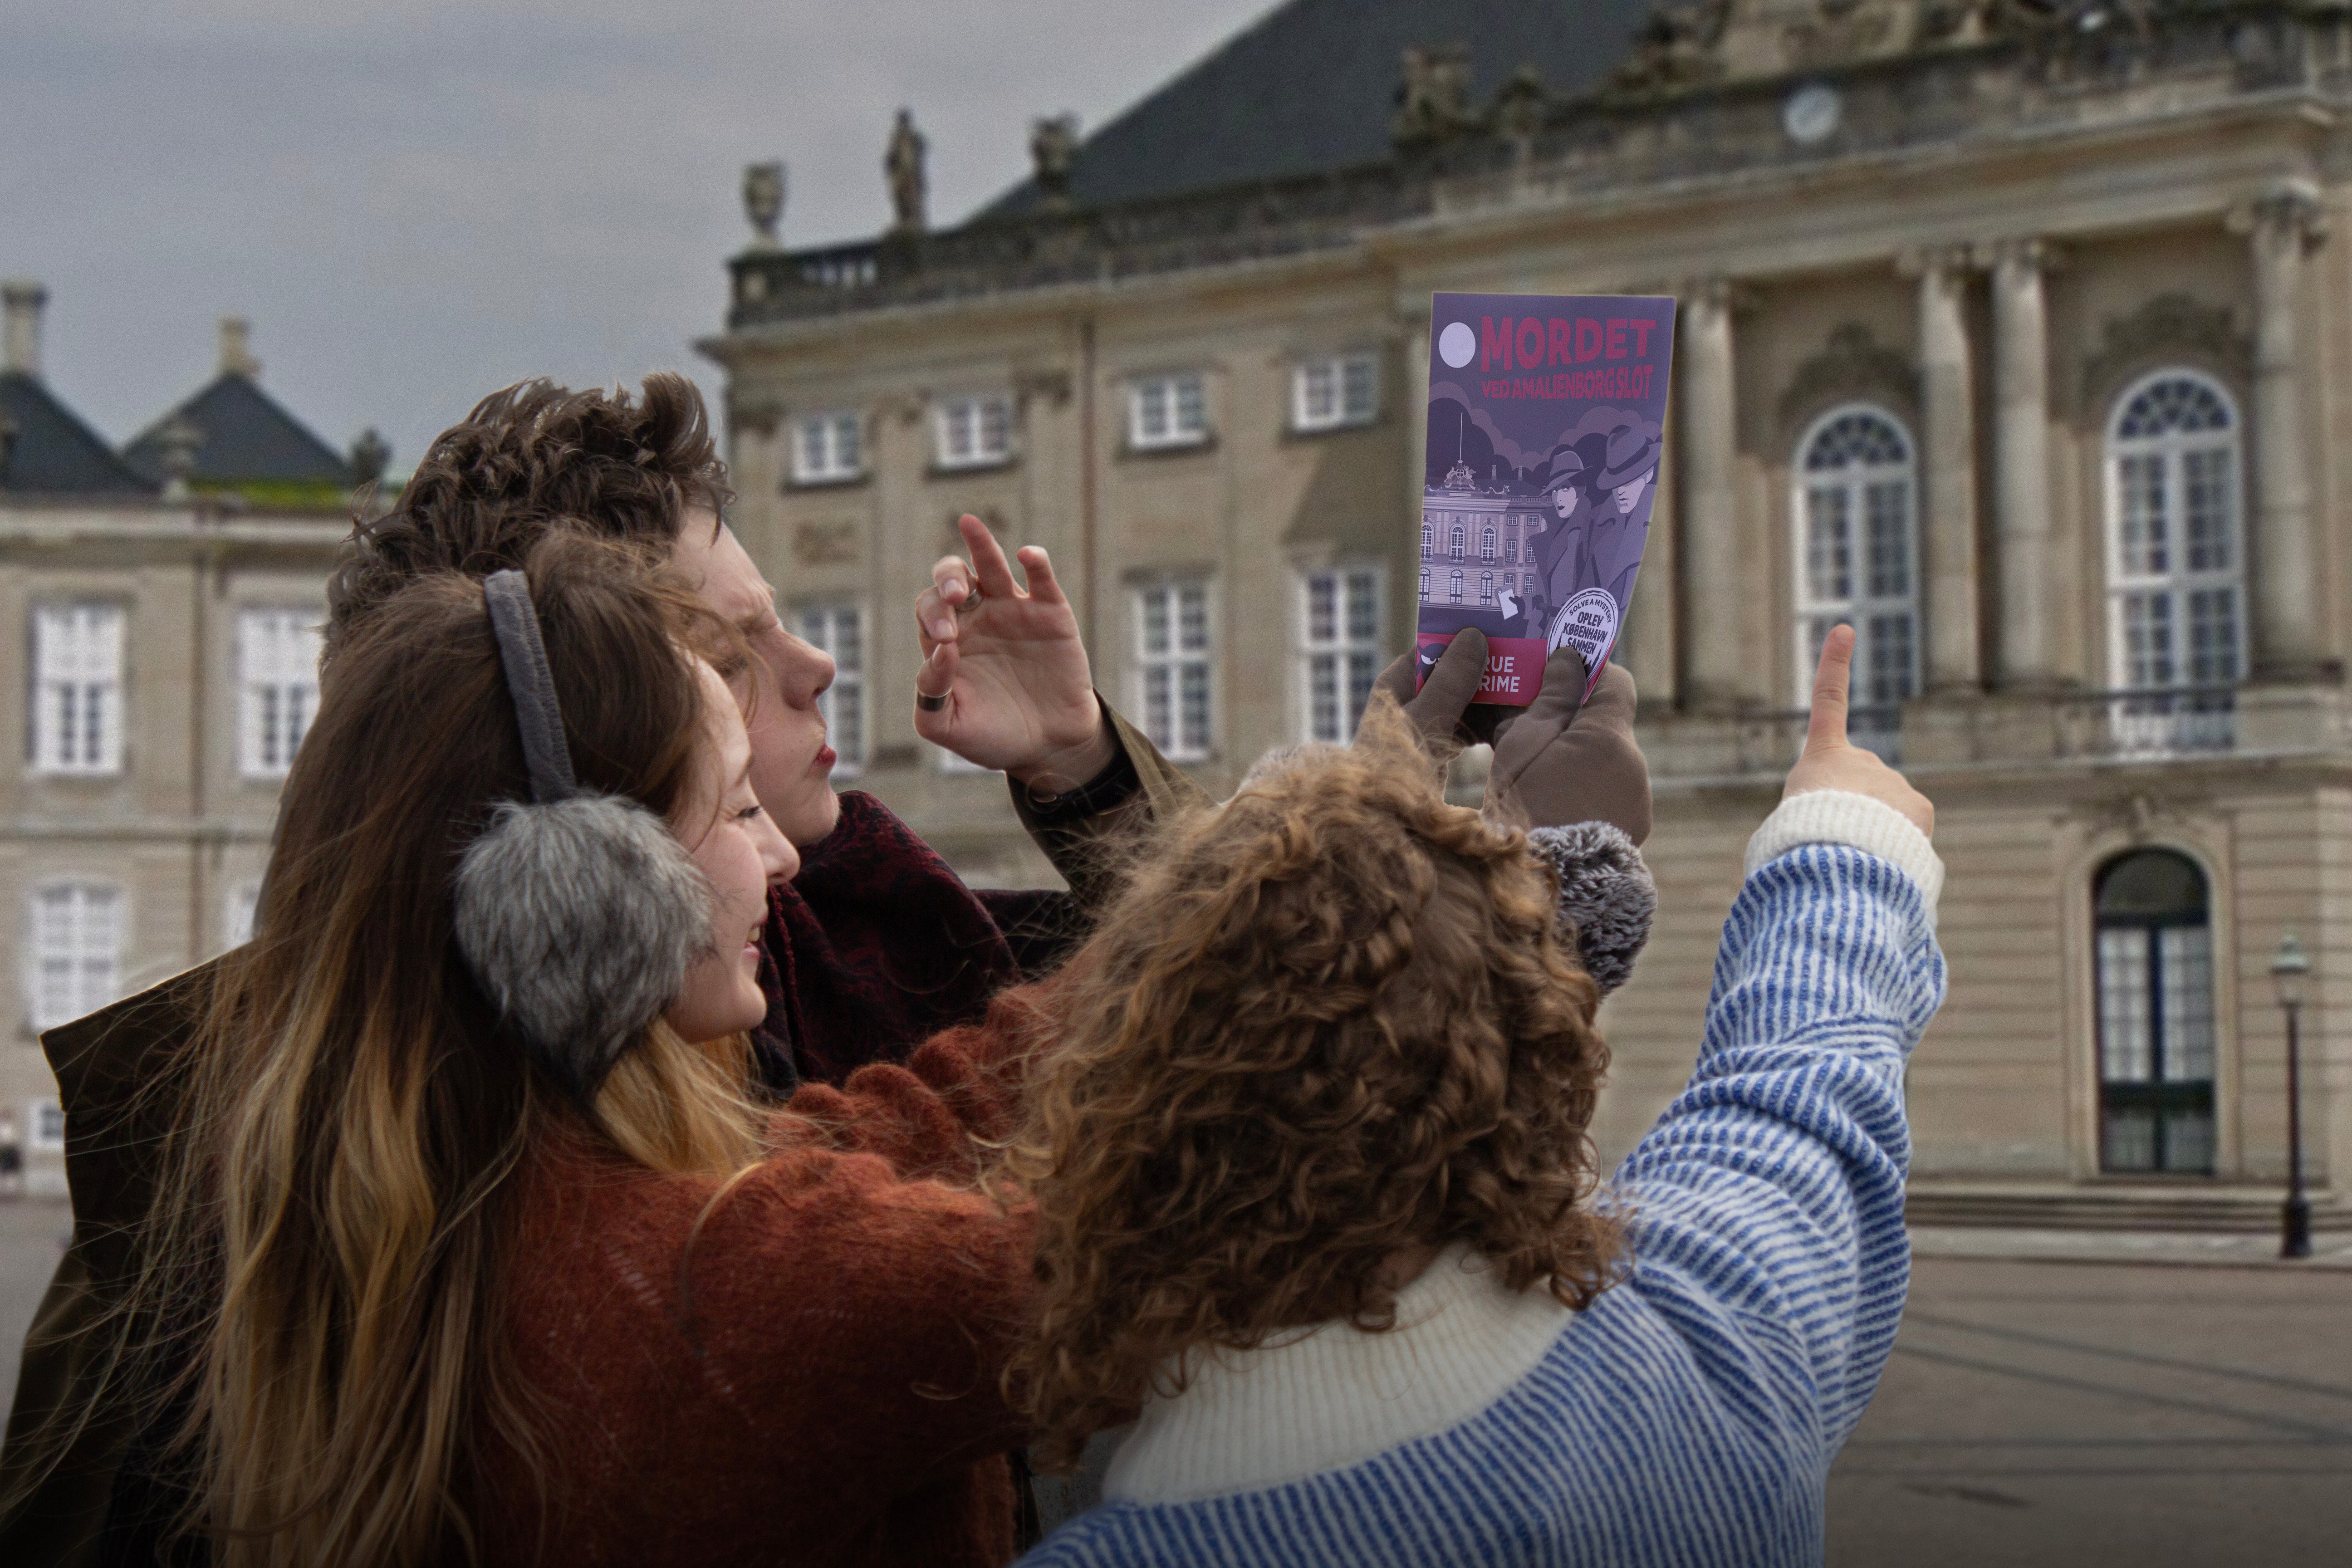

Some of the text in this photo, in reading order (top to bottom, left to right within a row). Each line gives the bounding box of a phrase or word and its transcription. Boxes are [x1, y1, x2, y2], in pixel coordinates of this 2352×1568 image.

[1481, 316, 1656, 372] MORDET
[1481, 364, 1653, 399] VED AMALIENBORG SLOT
[1569, 599, 1589, 616] SOLVE
[1594, 599, 1612, 623] MYSTERY
[1577, 611, 1604, 627] OPLEV
[1563, 622, 1608, 643] KØBENHAVN
[1567, 637, 1597, 655] SAMMEN
[1485, 656, 1515, 673] RUE
[1479, 675, 1520, 693] RIME
